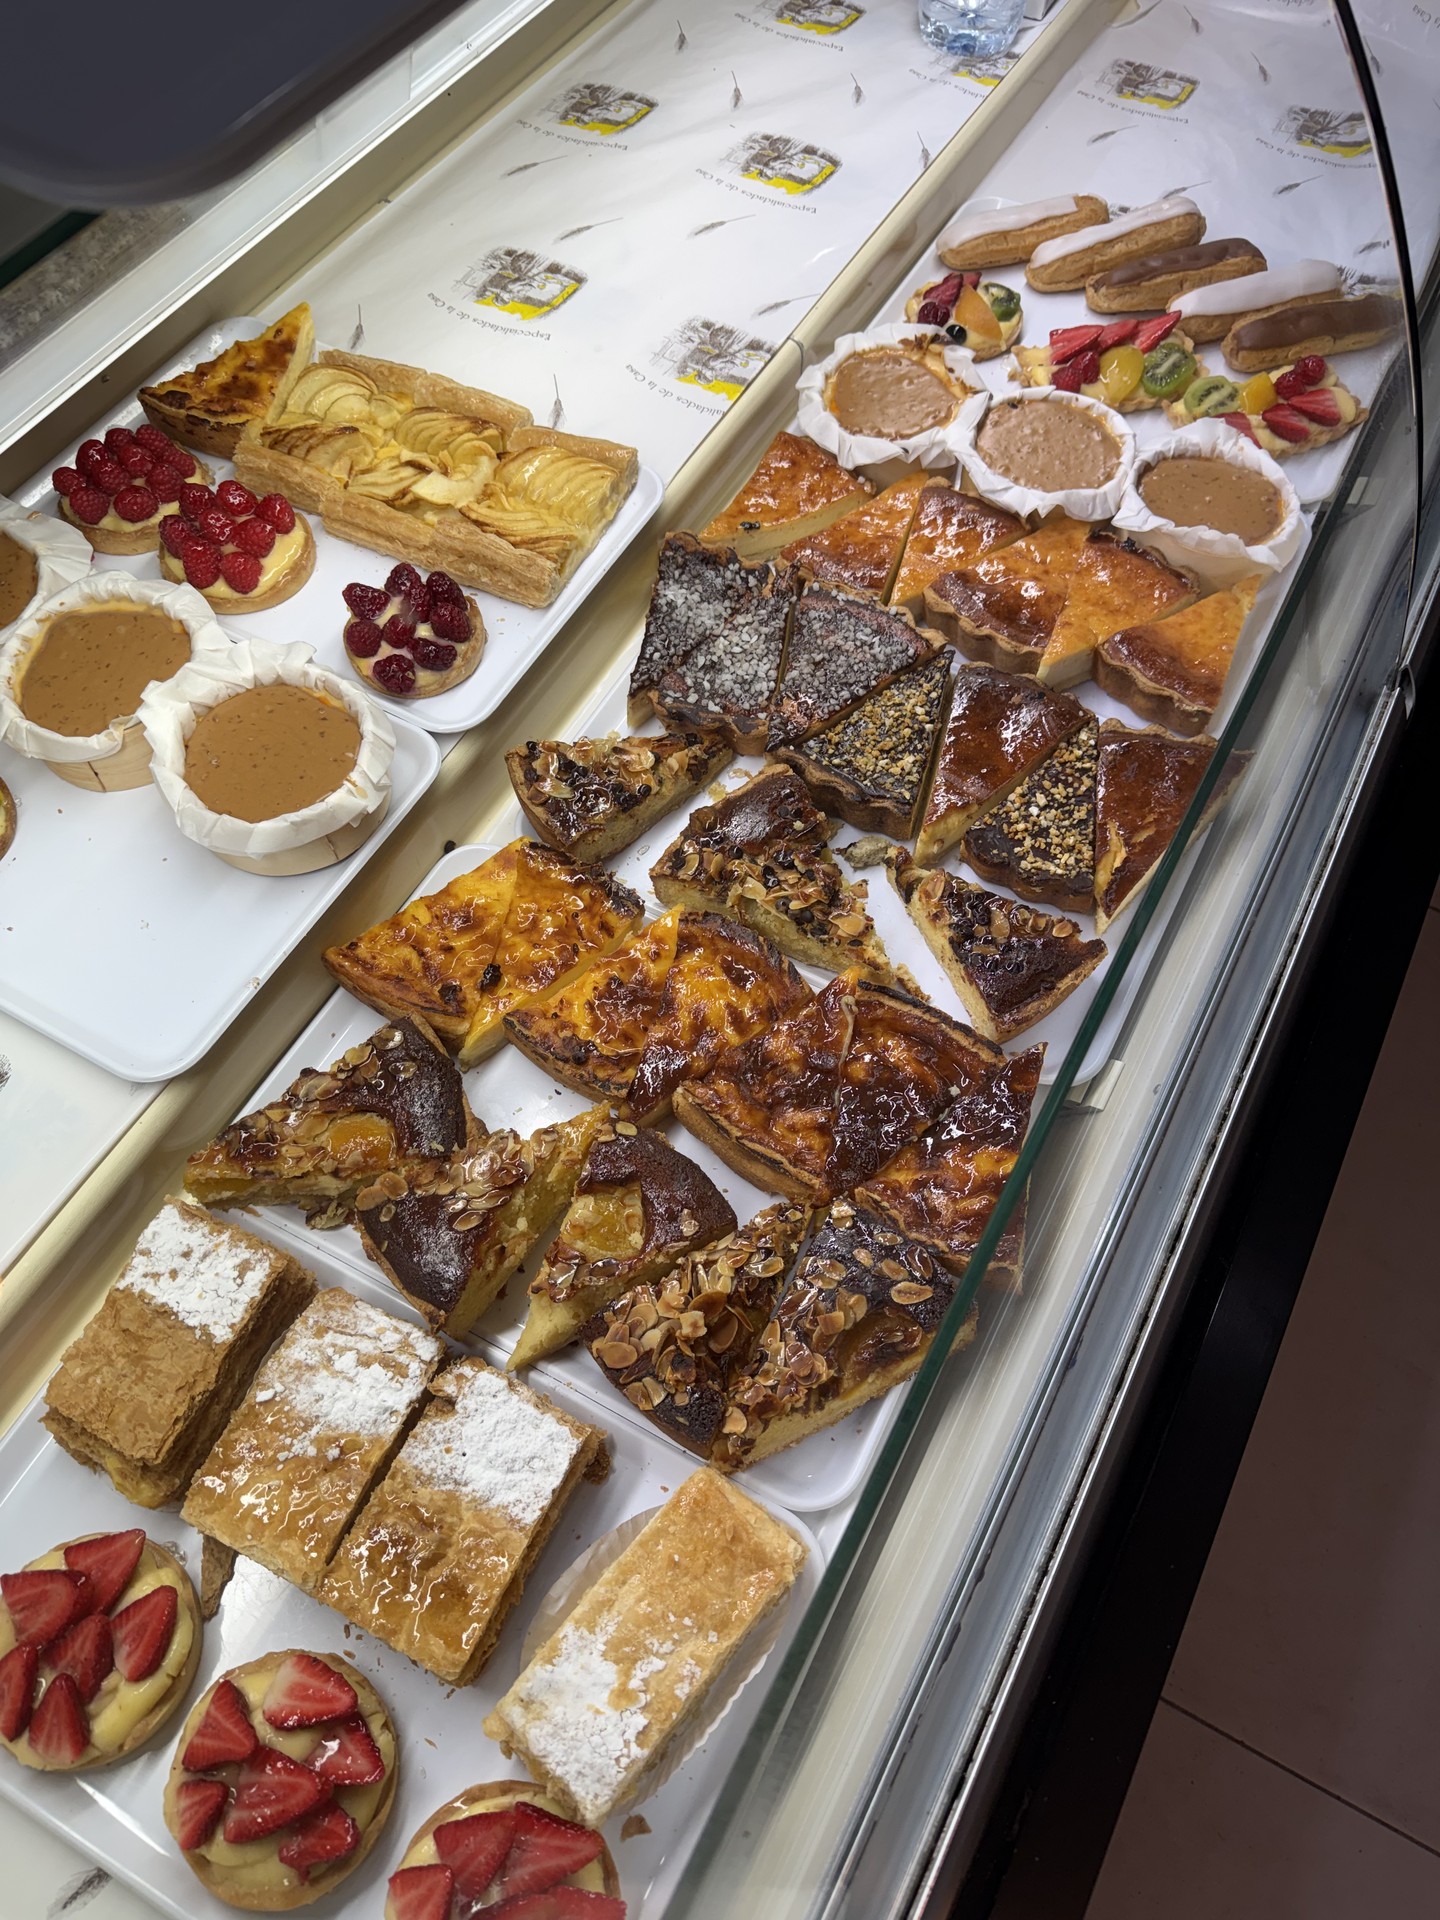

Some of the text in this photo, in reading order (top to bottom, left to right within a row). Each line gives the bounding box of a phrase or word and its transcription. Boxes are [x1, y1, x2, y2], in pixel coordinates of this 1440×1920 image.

[1412, 4, 1432, 24] Casa
[695, 168, 817, 214] Especialidades de la Casa
[427, 292, 552, 341] Especialidades de la Casa
[625, 364, 646, 383] Casa
[647, 380, 658, 391] la
[658, 387, 674, 398] de
